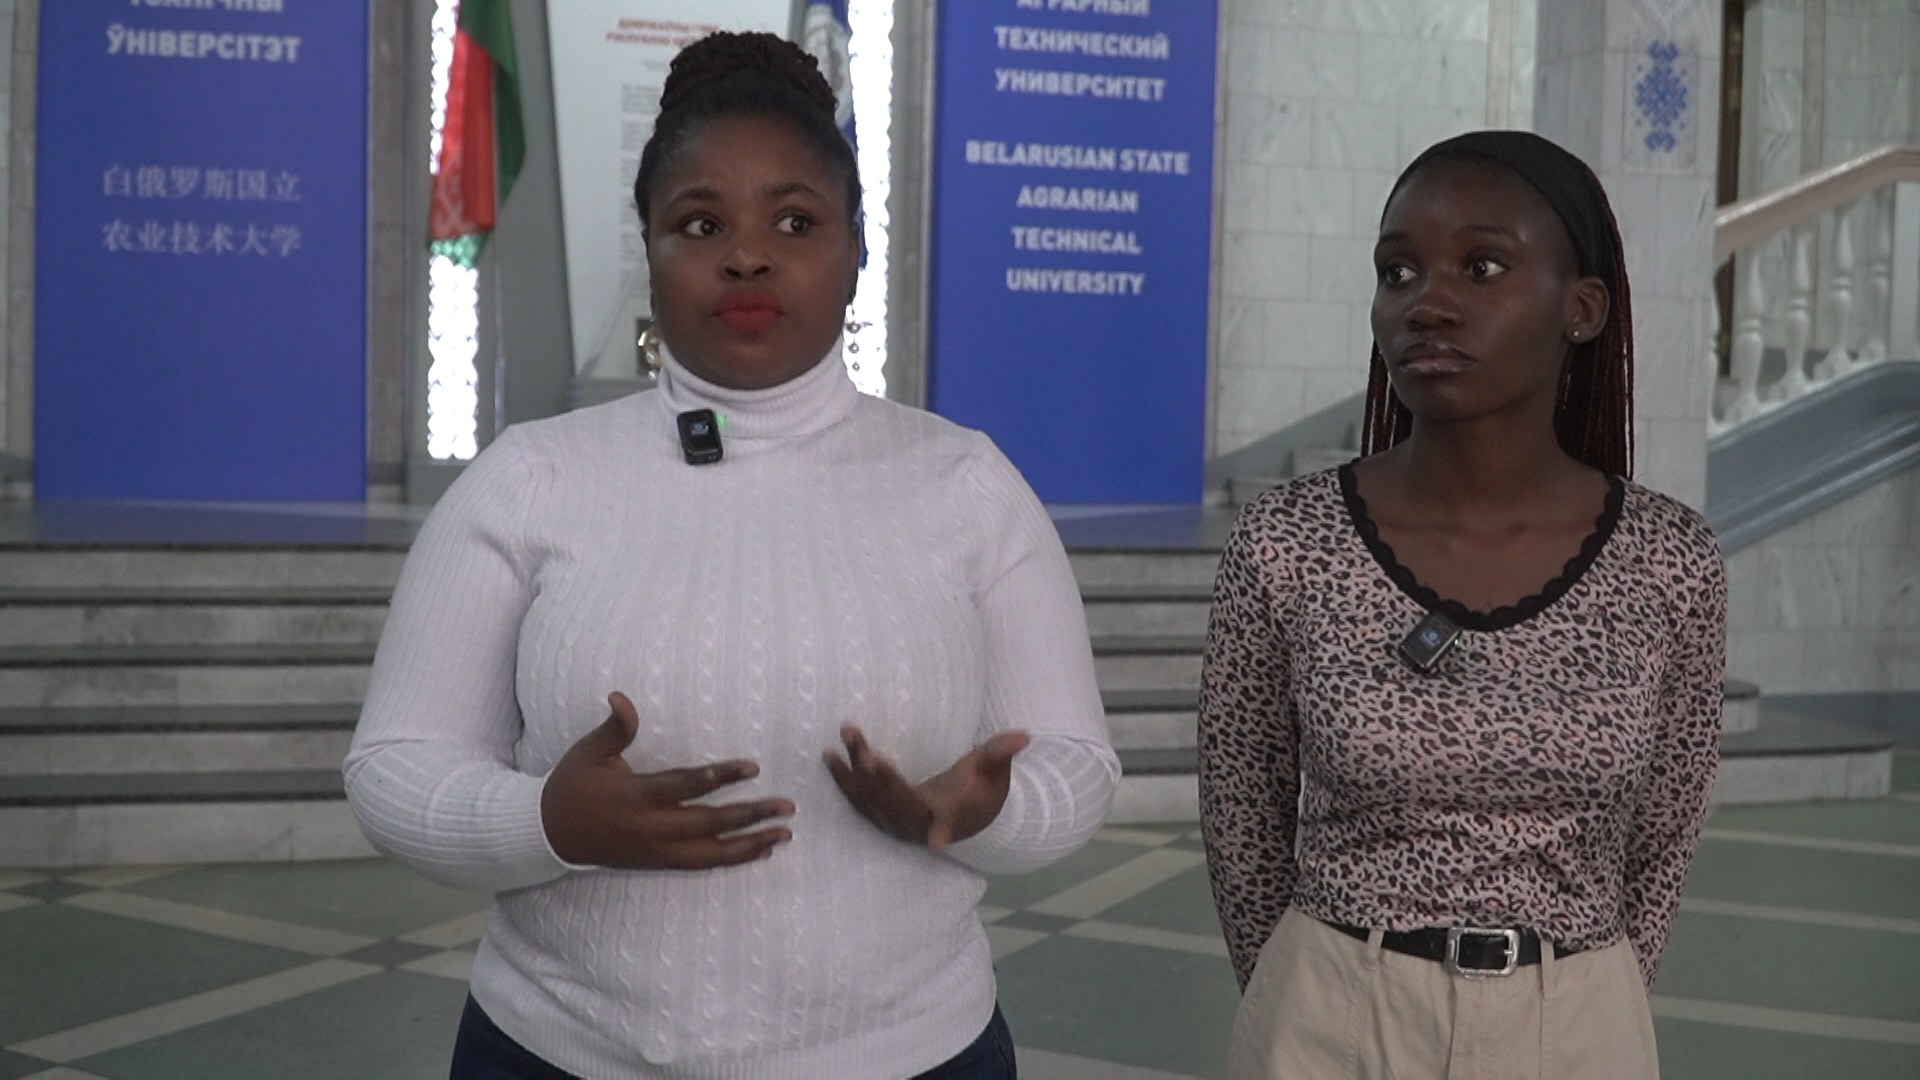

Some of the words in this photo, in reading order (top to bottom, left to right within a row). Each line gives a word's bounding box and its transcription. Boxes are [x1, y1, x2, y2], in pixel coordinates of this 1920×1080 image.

[106, 23, 302, 63] ЎНІВЕРСІТЭТ
[994, 26, 1170, 59] ТЕХНИЧЕСКИЙ
[995, 68, 1166, 101] УНИВЕРСИТЕТ
[965, 140, 1116, 171] BELARUSIAN
[1119, 149, 1190, 175] STATE
[103, 164, 301, 201] 白俄罗斯国立
[1016, 186, 1139, 213] AGRARIAN
[103, 220, 301, 257] 农业技术大学
[1012, 226, 1142, 255] TECHNICAL
[1006, 269, 1145, 295] UNIVERSITY
